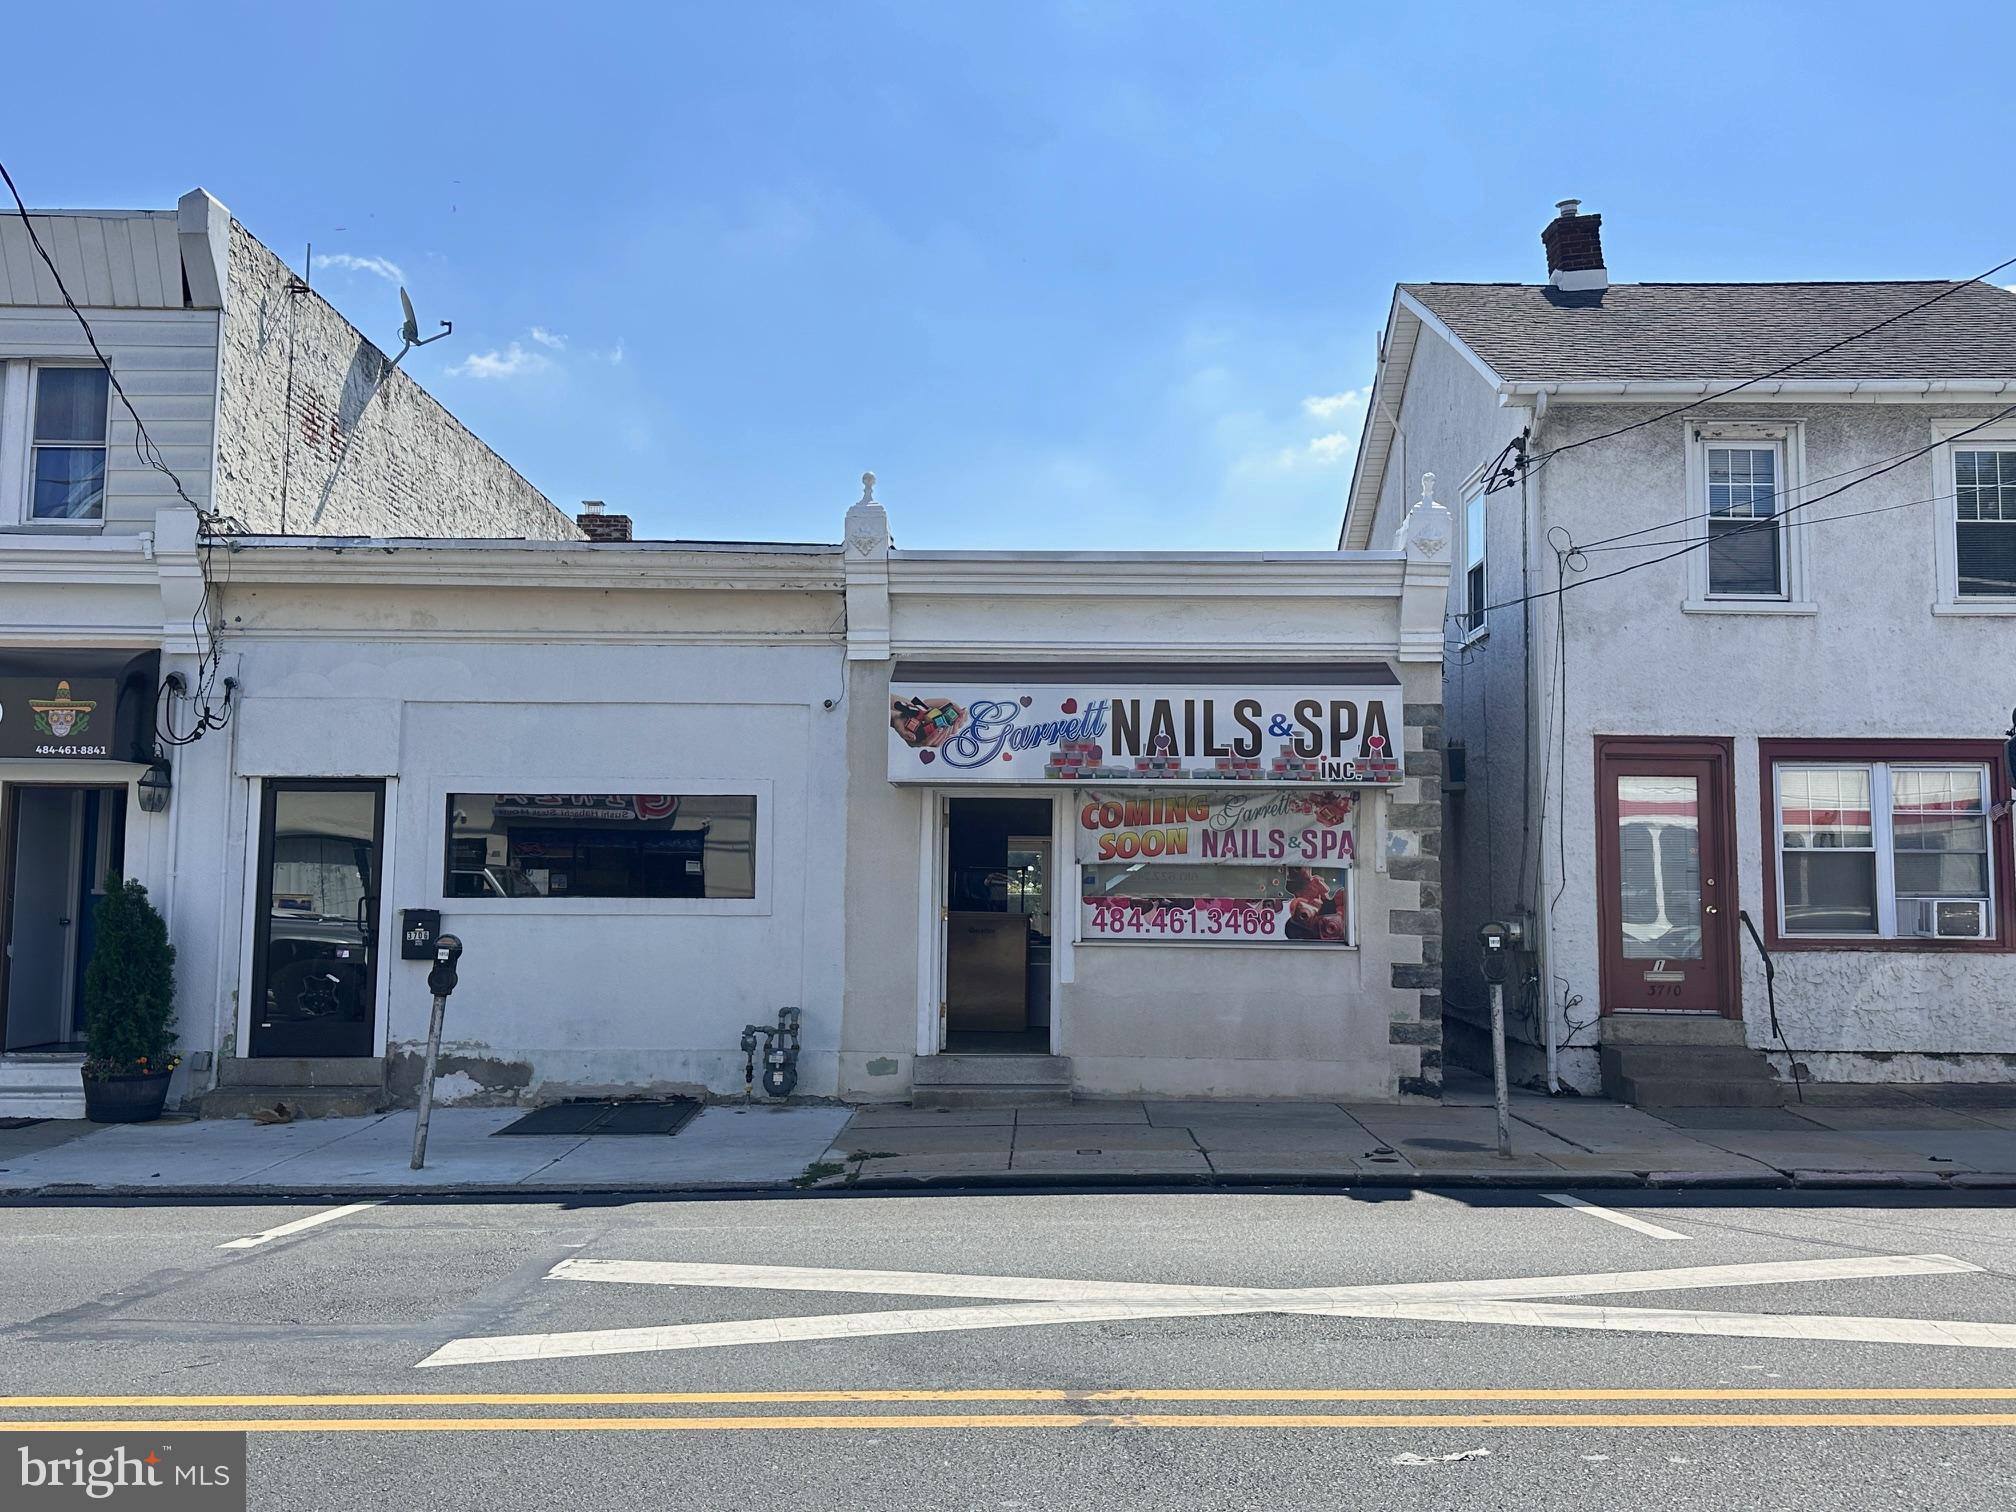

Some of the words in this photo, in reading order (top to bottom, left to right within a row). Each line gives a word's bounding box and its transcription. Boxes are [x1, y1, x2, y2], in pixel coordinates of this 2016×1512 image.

[36, 745, 106, 755] 484-461-8841
[941, 700, 1111, 769] Garrett
[1111, 699, 1262, 758] NAILS
[1268, 713, 1293, 737] &
[1294, 700, 1394, 758] SPA
[1081, 795, 1210, 830] COMING
[1209, 795, 1292, 831] Garrett
[1098, 828, 1188, 860] SOON
[1201, 828, 1285, 859] NAILS
[1288, 837, 1302, 849] &
[1302, 830, 1356, 860] SPA
[1091, 907, 1276, 935] 484.461.3468
[1647, 984, 1681, 997] 3710
